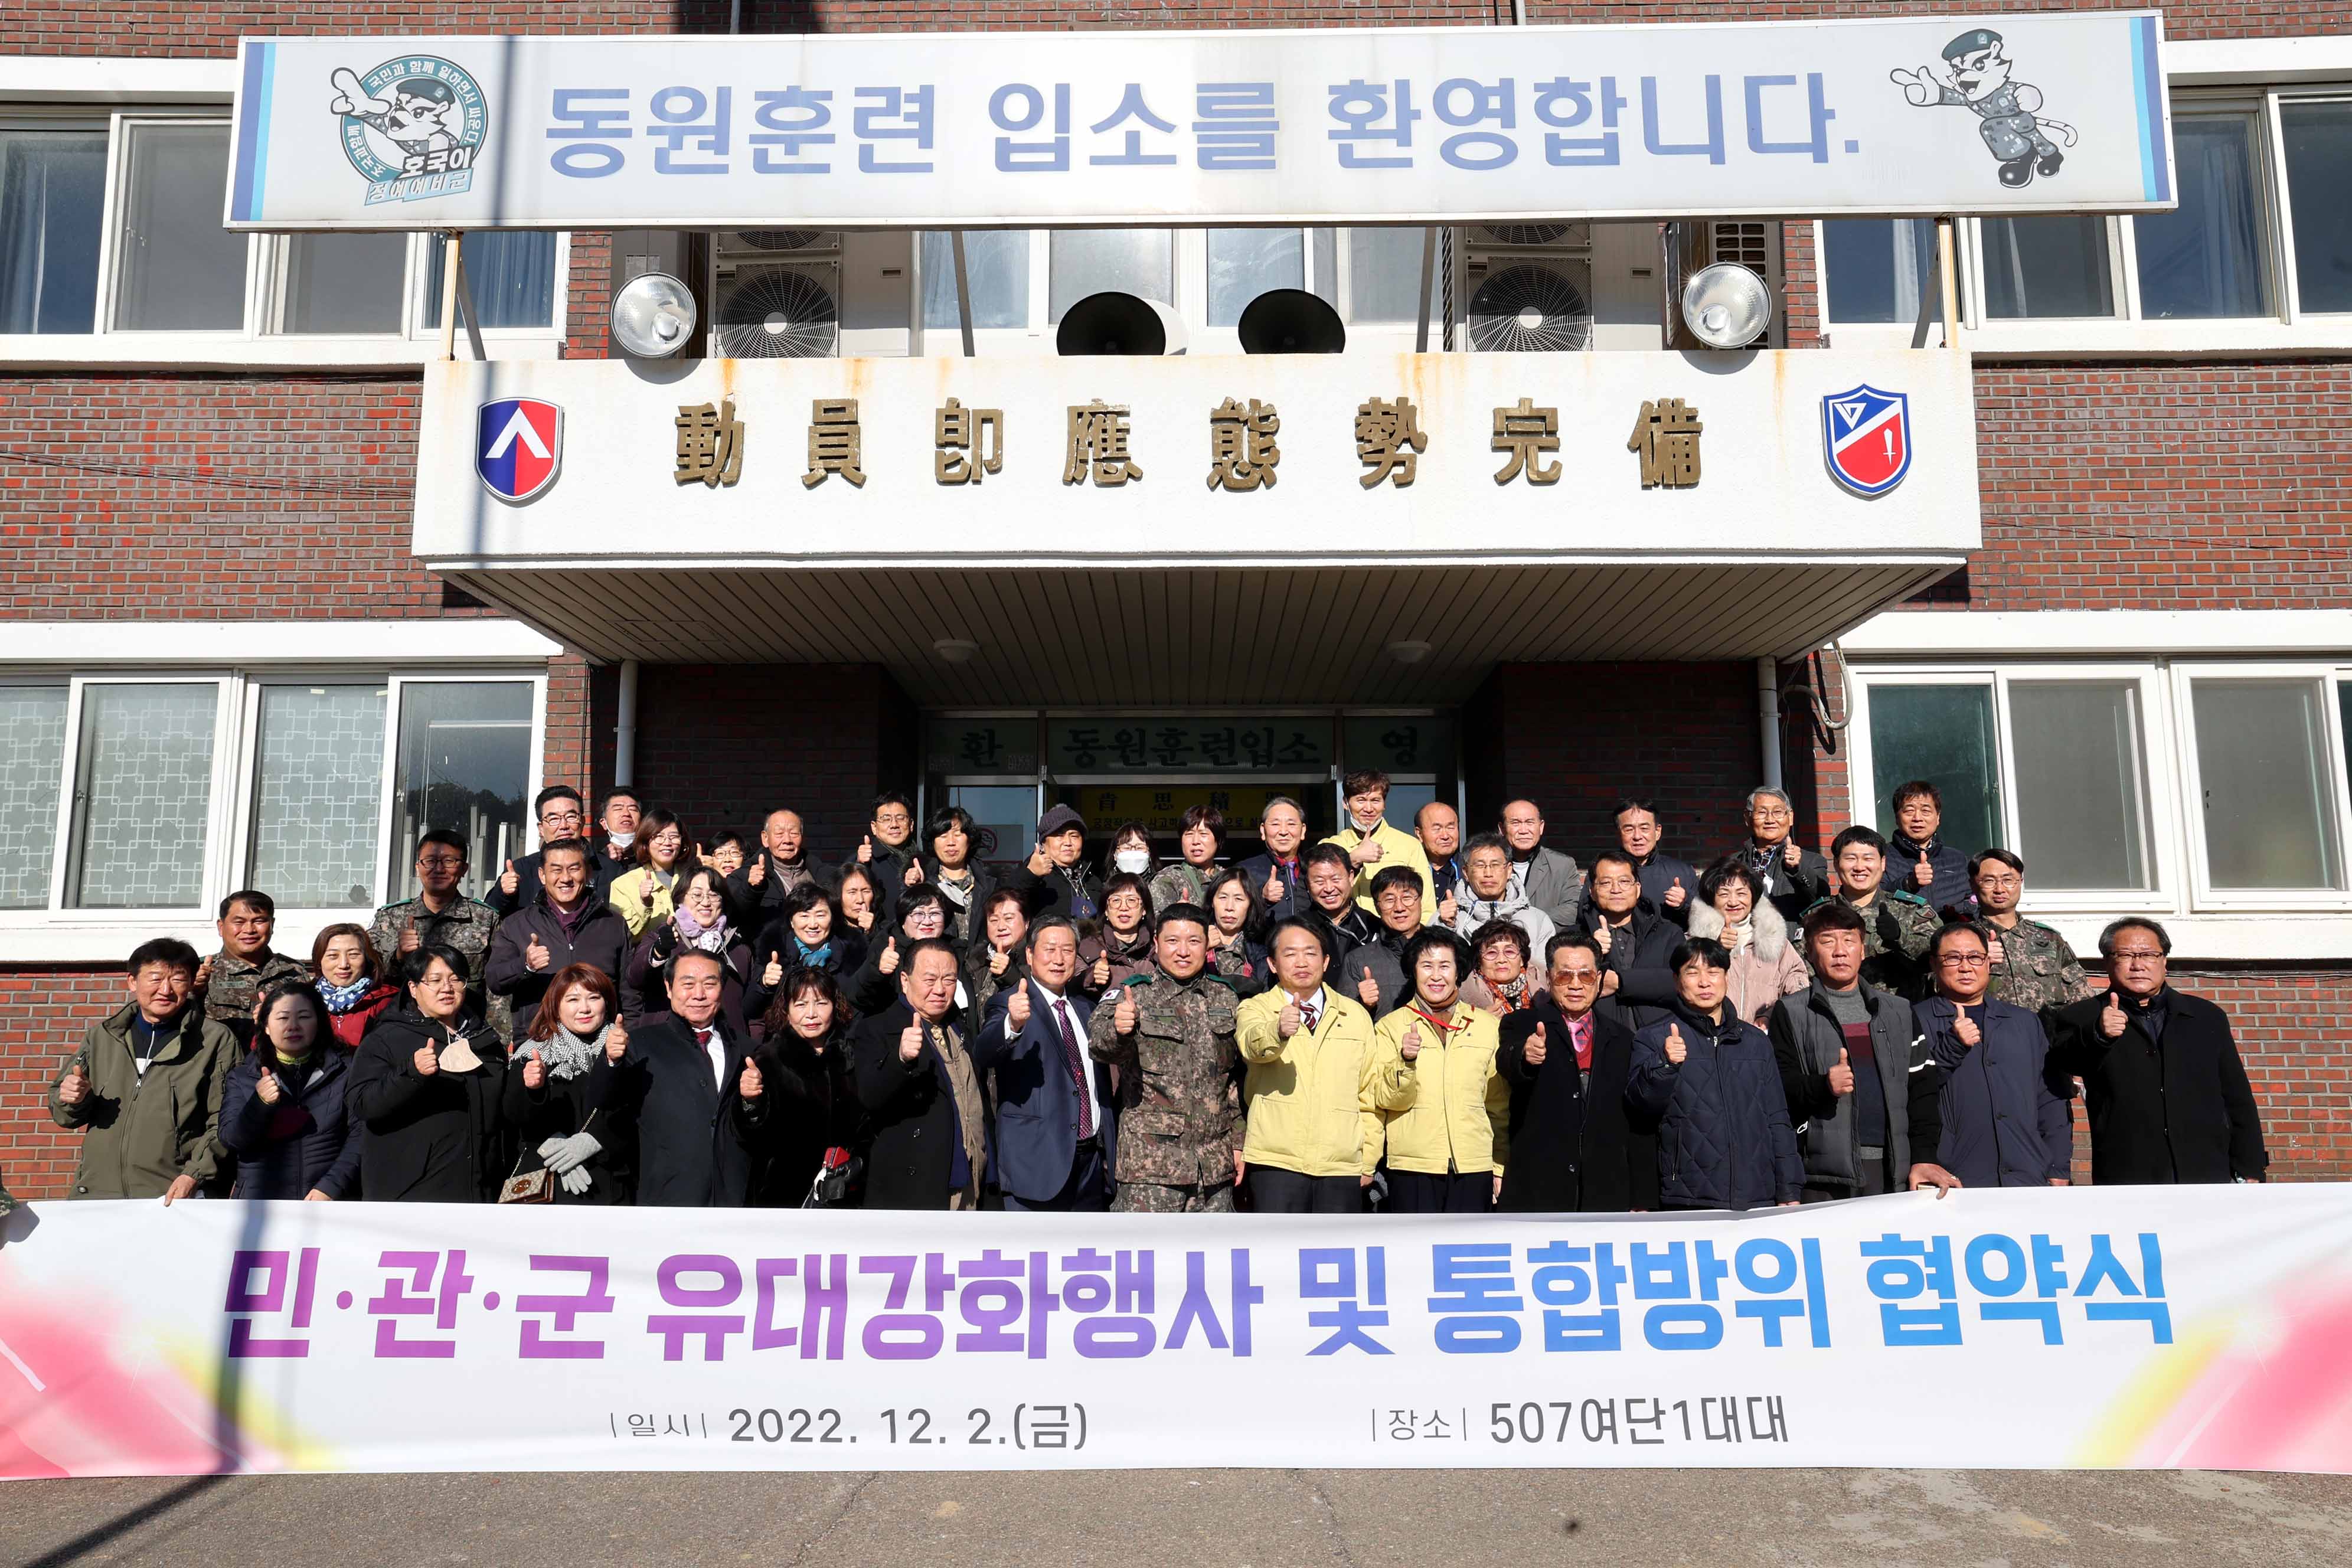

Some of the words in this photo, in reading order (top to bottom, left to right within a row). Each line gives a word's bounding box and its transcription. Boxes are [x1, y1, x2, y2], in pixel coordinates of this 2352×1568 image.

[368, 63, 406, 88] 국민과
[409, 60, 435, 74] 함께
[439, 66, 478, 105] 일하면서
[545, 84, 936, 178] 동원훈련
[988, 82, 1280, 172] 입소를
[1328, 72, 1859, 171] 환영합니다.
[398, 146, 472, 178] 호국이
[961, 727, 1004, 767] 환
[1062, 726, 1320, 768] 동원훈련입소
[1381, 726, 1418, 767] 영
[224, 1246, 616, 1360] 민·관·군
[646, 1247, 1265, 1361] 유대강화행사
[1298, 1246, 1396, 1357] 및
[1427, 1237, 1831, 1354] 통합방위
[1860, 1231, 2174, 1348] 협약식
[729, 1408, 858, 1444] 2022.
[880, 1408, 946, 1445] 12.
[967, 1402, 1087, 1451] 2.(금)
[1490, 1395, 1789, 1445] 507여단1대대
